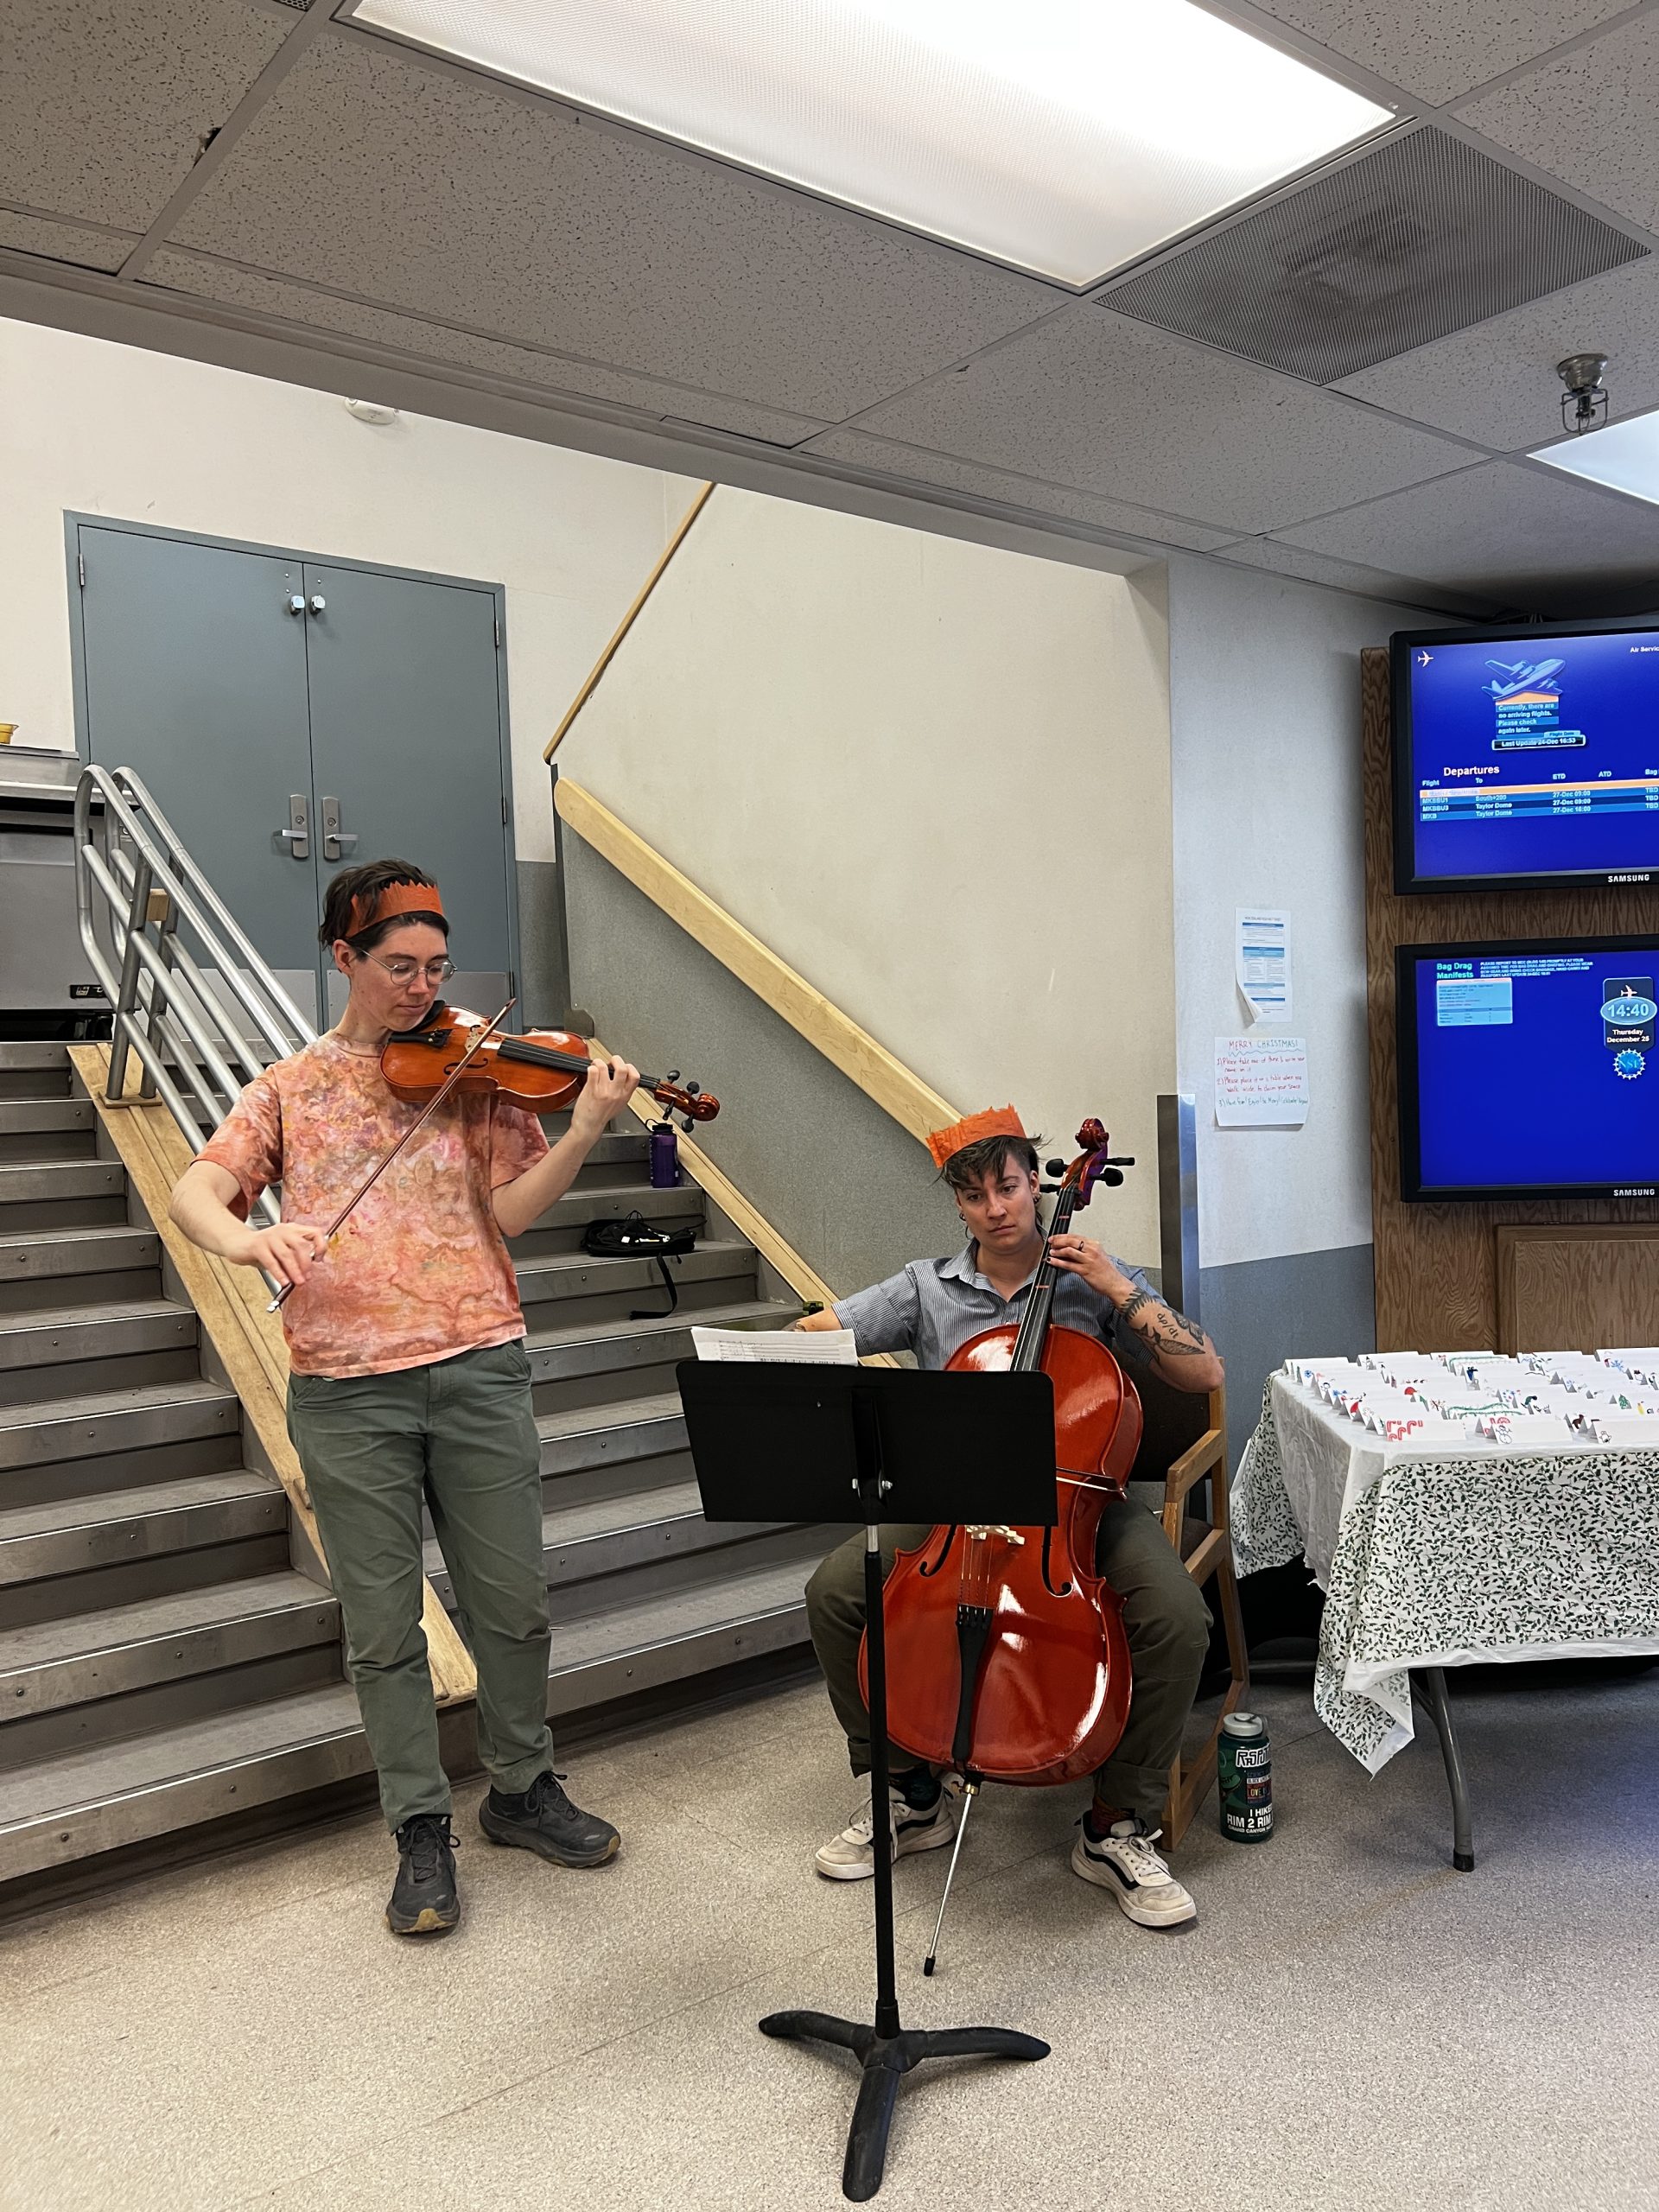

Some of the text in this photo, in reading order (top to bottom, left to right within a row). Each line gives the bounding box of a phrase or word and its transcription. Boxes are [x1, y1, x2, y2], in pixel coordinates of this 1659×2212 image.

[1443, 766, 1500, 778] Departures
[1607, 874, 1650, 883] SAMSUNG
[1607, 1003, 1649, 1018] 14:40
[1229, 1039, 1299, 1050] MERRY CHRISTMAS!
[1613, 1188, 1656, 1197] SAMSUNG
[1249, 1808, 1253, 1817] I
[1227, 1813, 1245, 1828] RIM
[1247, 1818, 1255, 1828] 2
